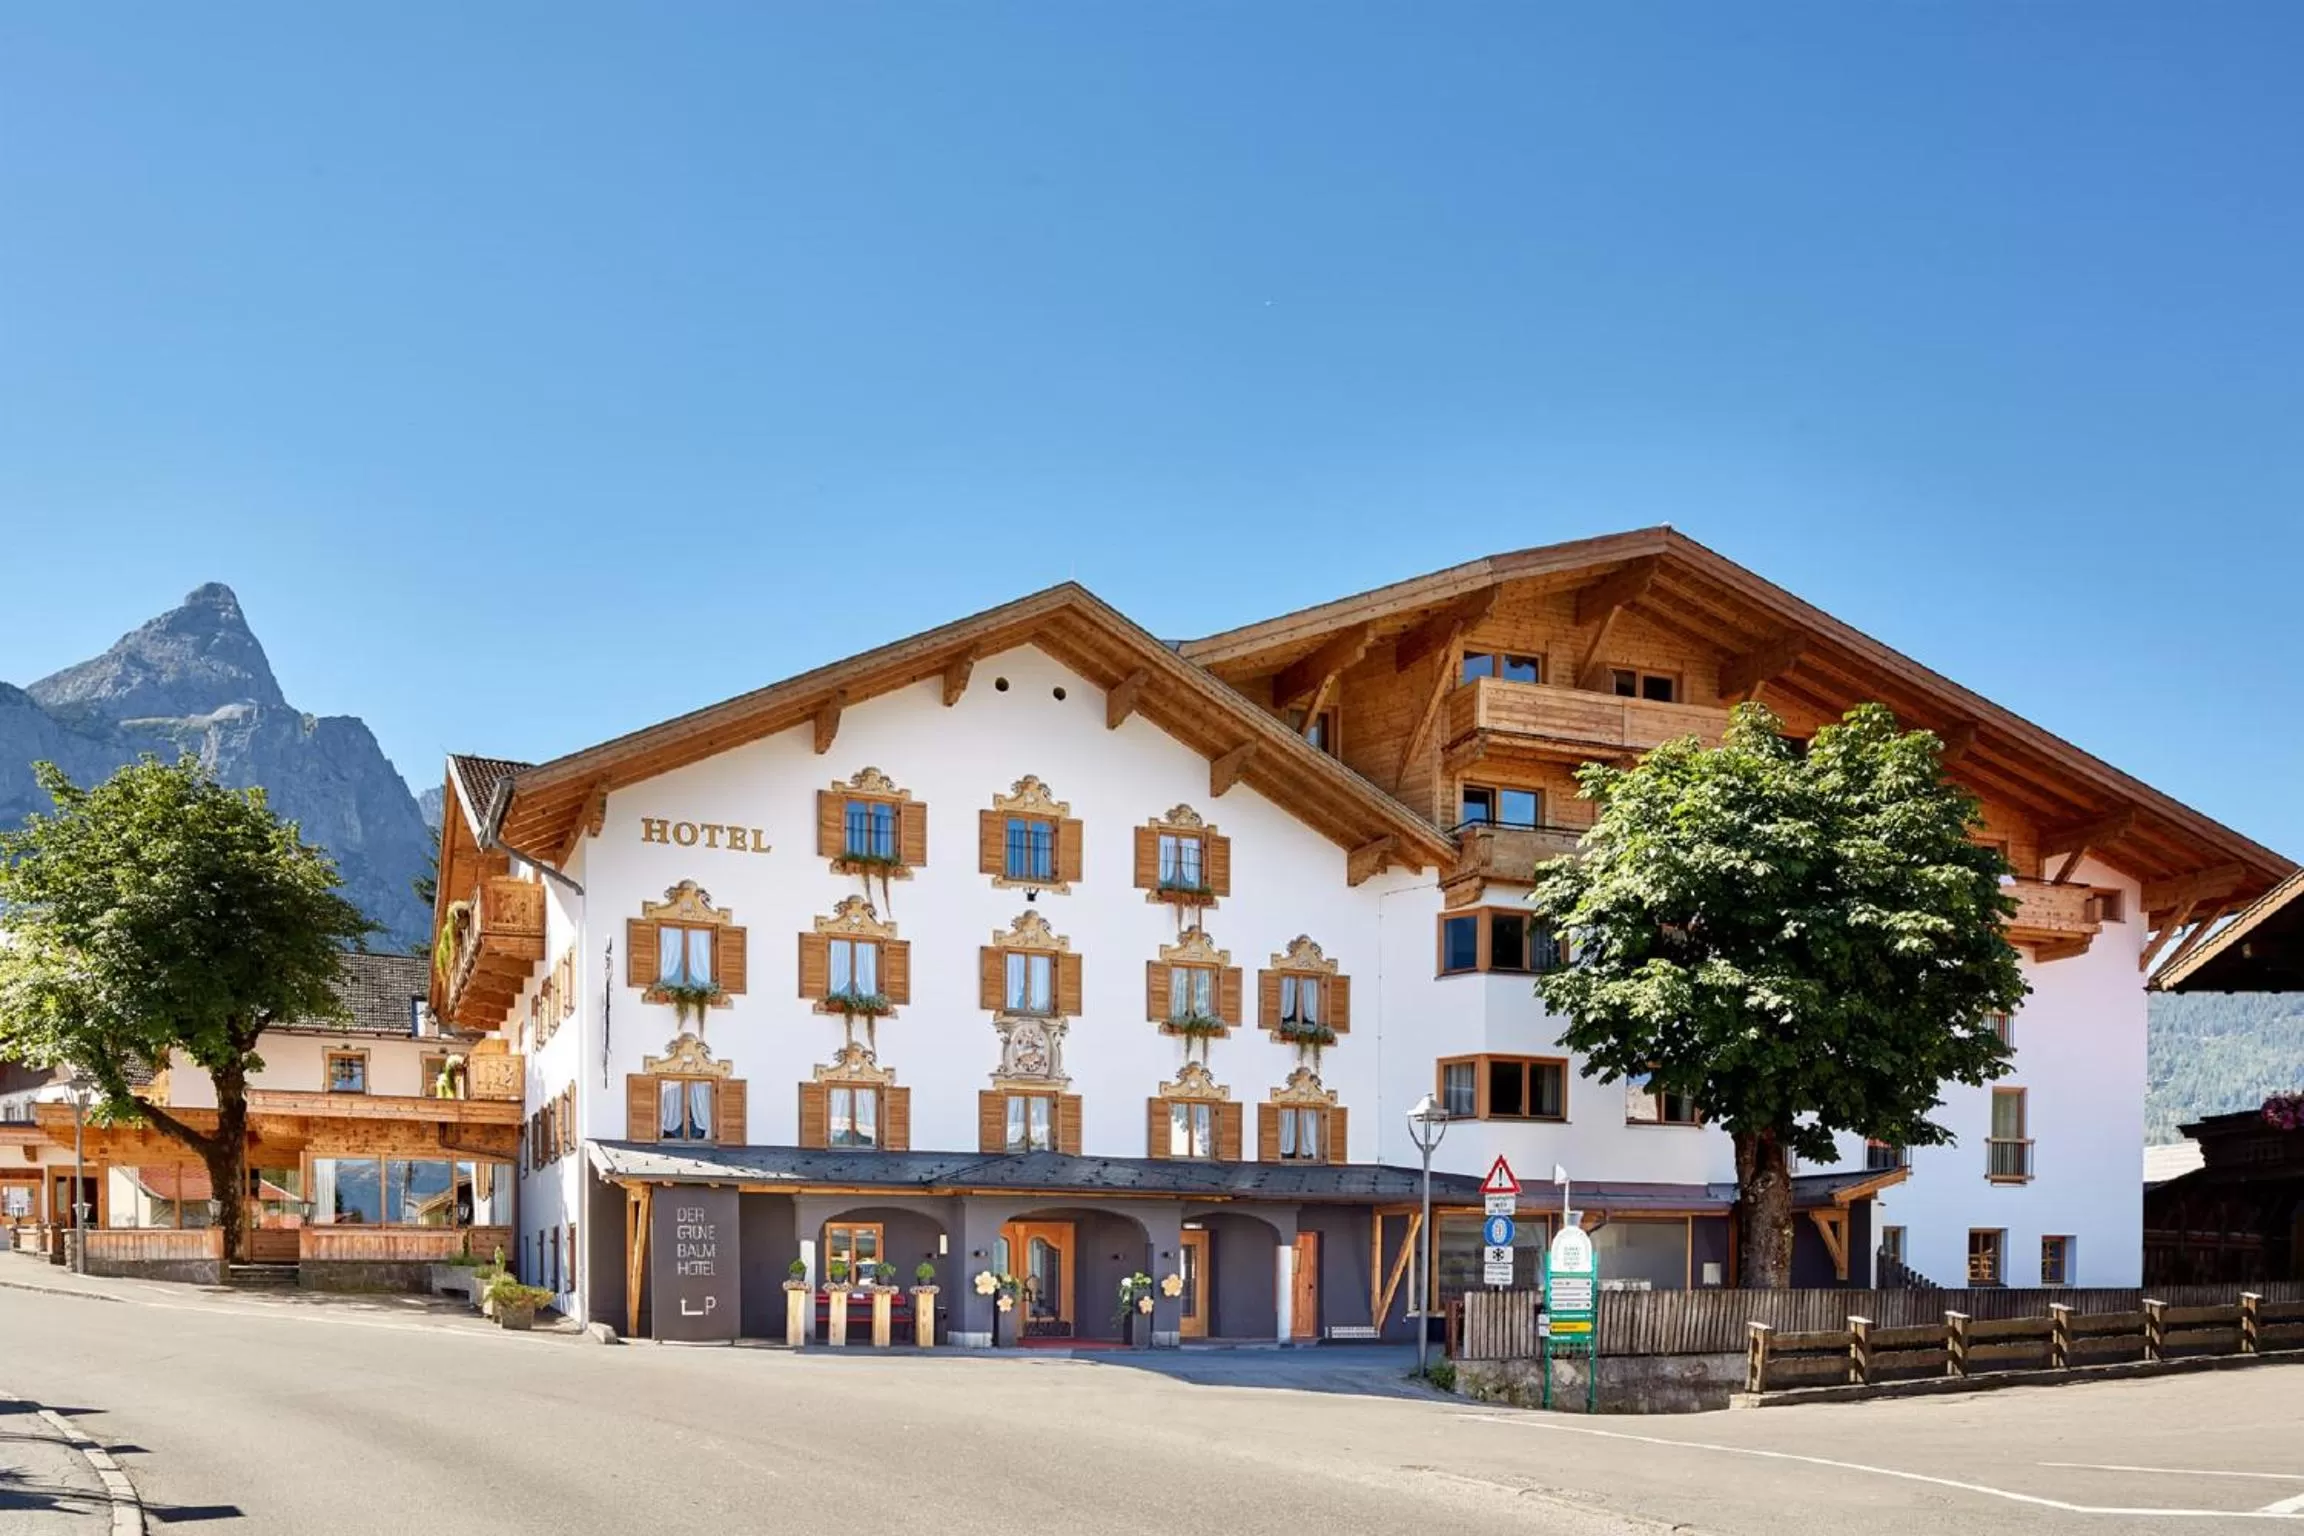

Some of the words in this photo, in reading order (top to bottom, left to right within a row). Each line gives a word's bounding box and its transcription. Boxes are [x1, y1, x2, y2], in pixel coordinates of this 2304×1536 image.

[641, 817, 772, 853] HOTEL
[676, 1207, 705, 1222] DER
[676, 1260, 717, 1276] HOTEL
[705, 1296, 717, 1315] P
